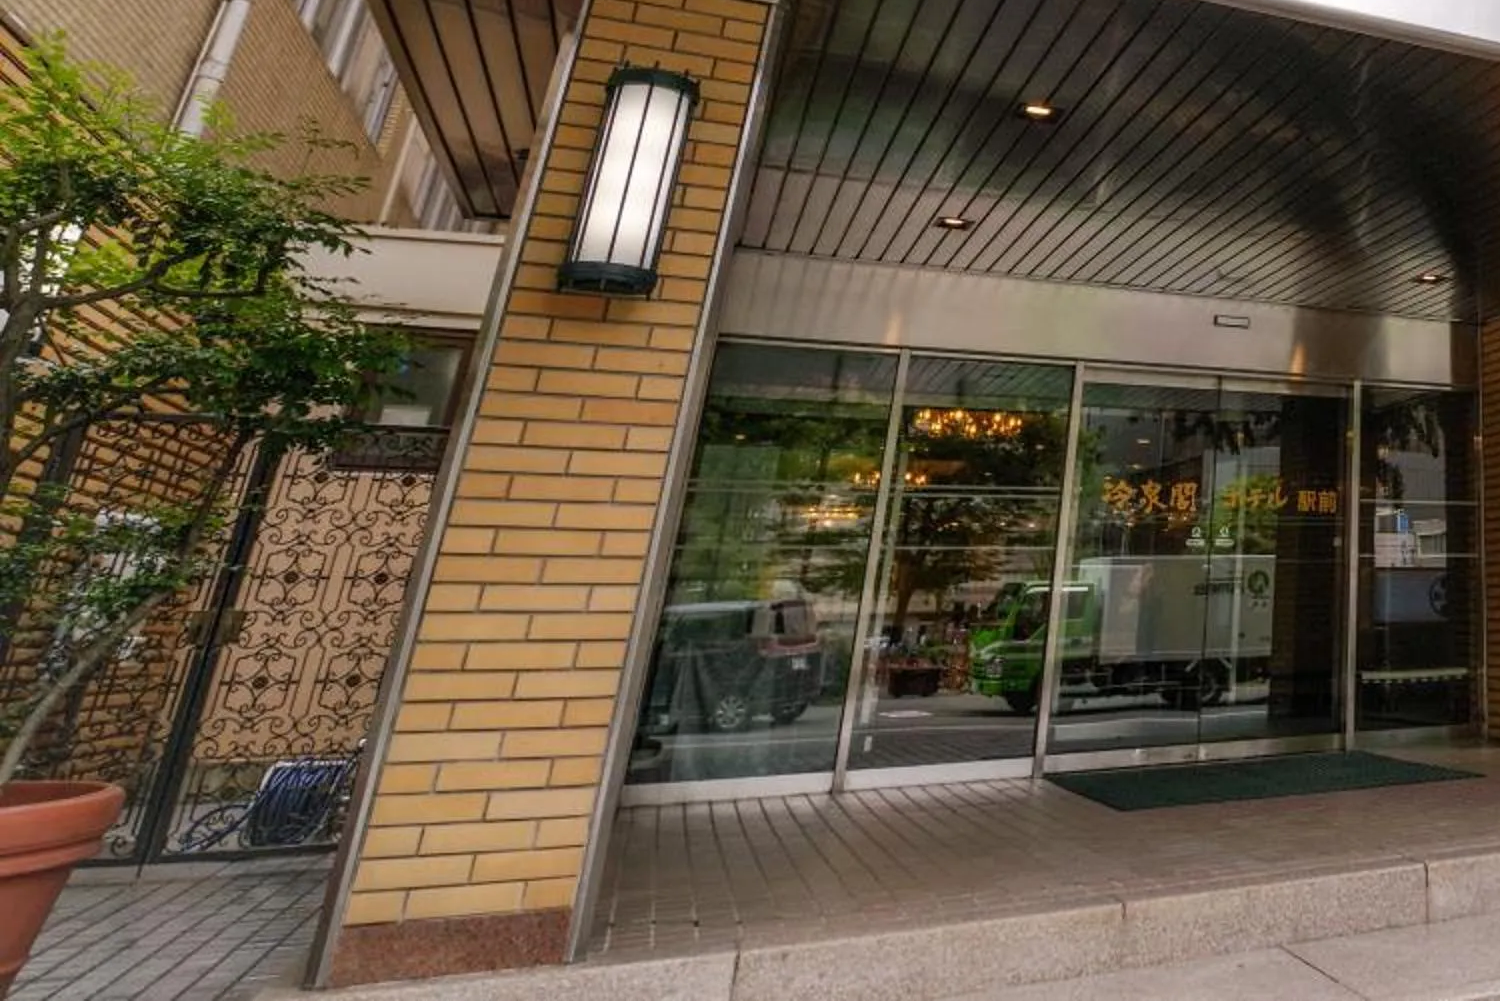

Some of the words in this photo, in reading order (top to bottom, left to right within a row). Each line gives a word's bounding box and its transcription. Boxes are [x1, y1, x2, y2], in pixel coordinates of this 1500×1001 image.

[1222, 485, 1288, 510] ホテル
[1296, 489, 1337, 514] 駅前
